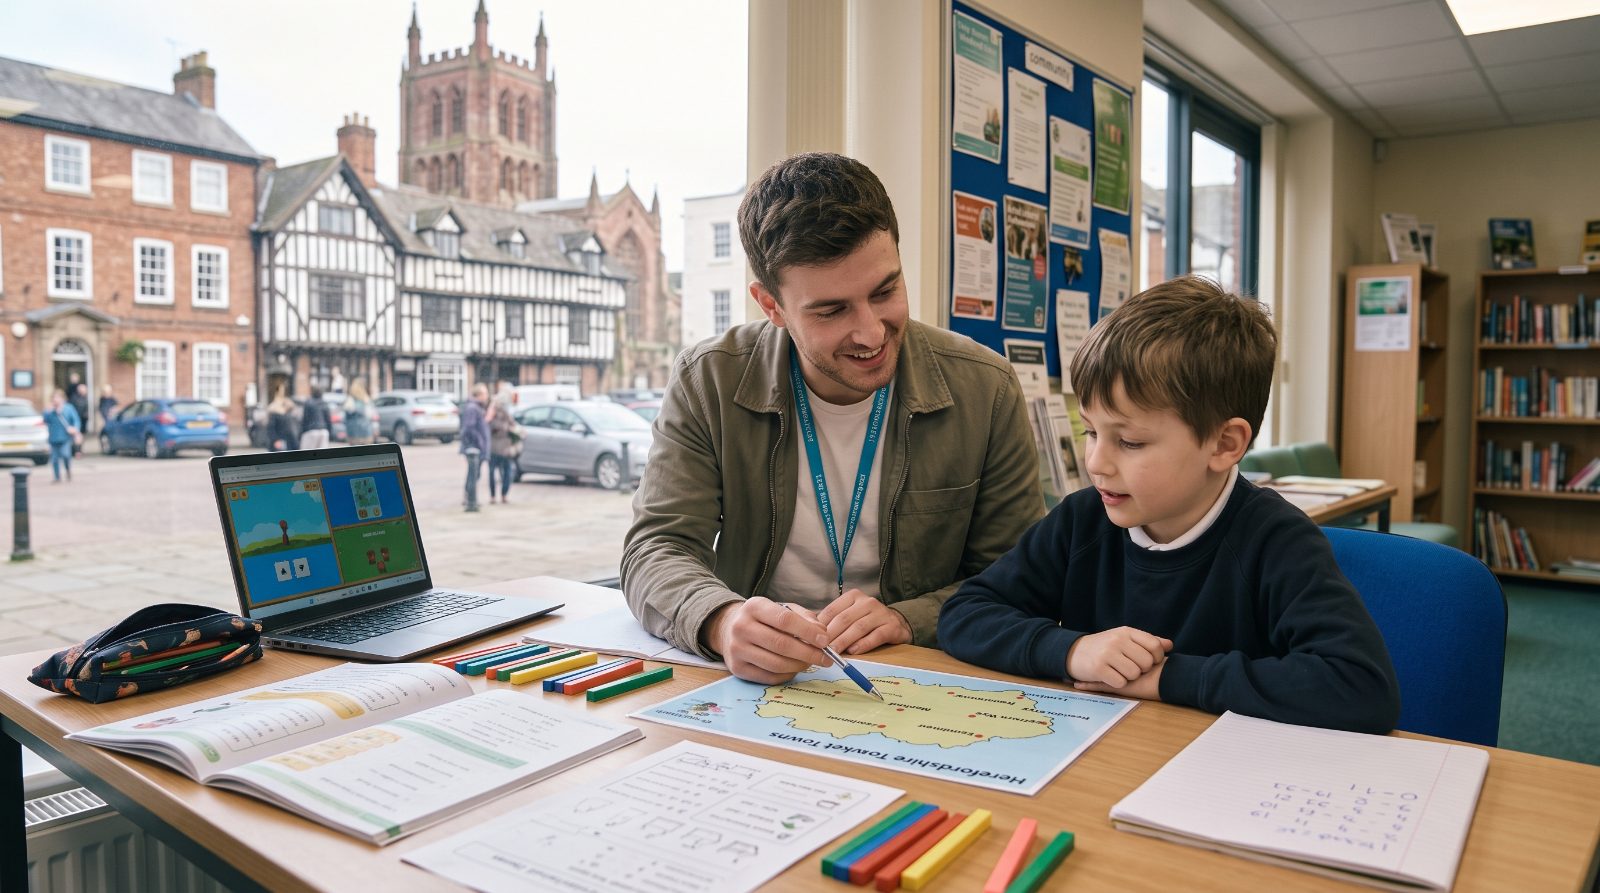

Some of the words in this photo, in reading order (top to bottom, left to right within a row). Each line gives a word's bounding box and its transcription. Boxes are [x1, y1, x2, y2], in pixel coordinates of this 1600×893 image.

[1030, 51, 1071, 84] community
[768, 731, 821, 748] Towns
[893, 754, 1027, 785] Herefordshire
